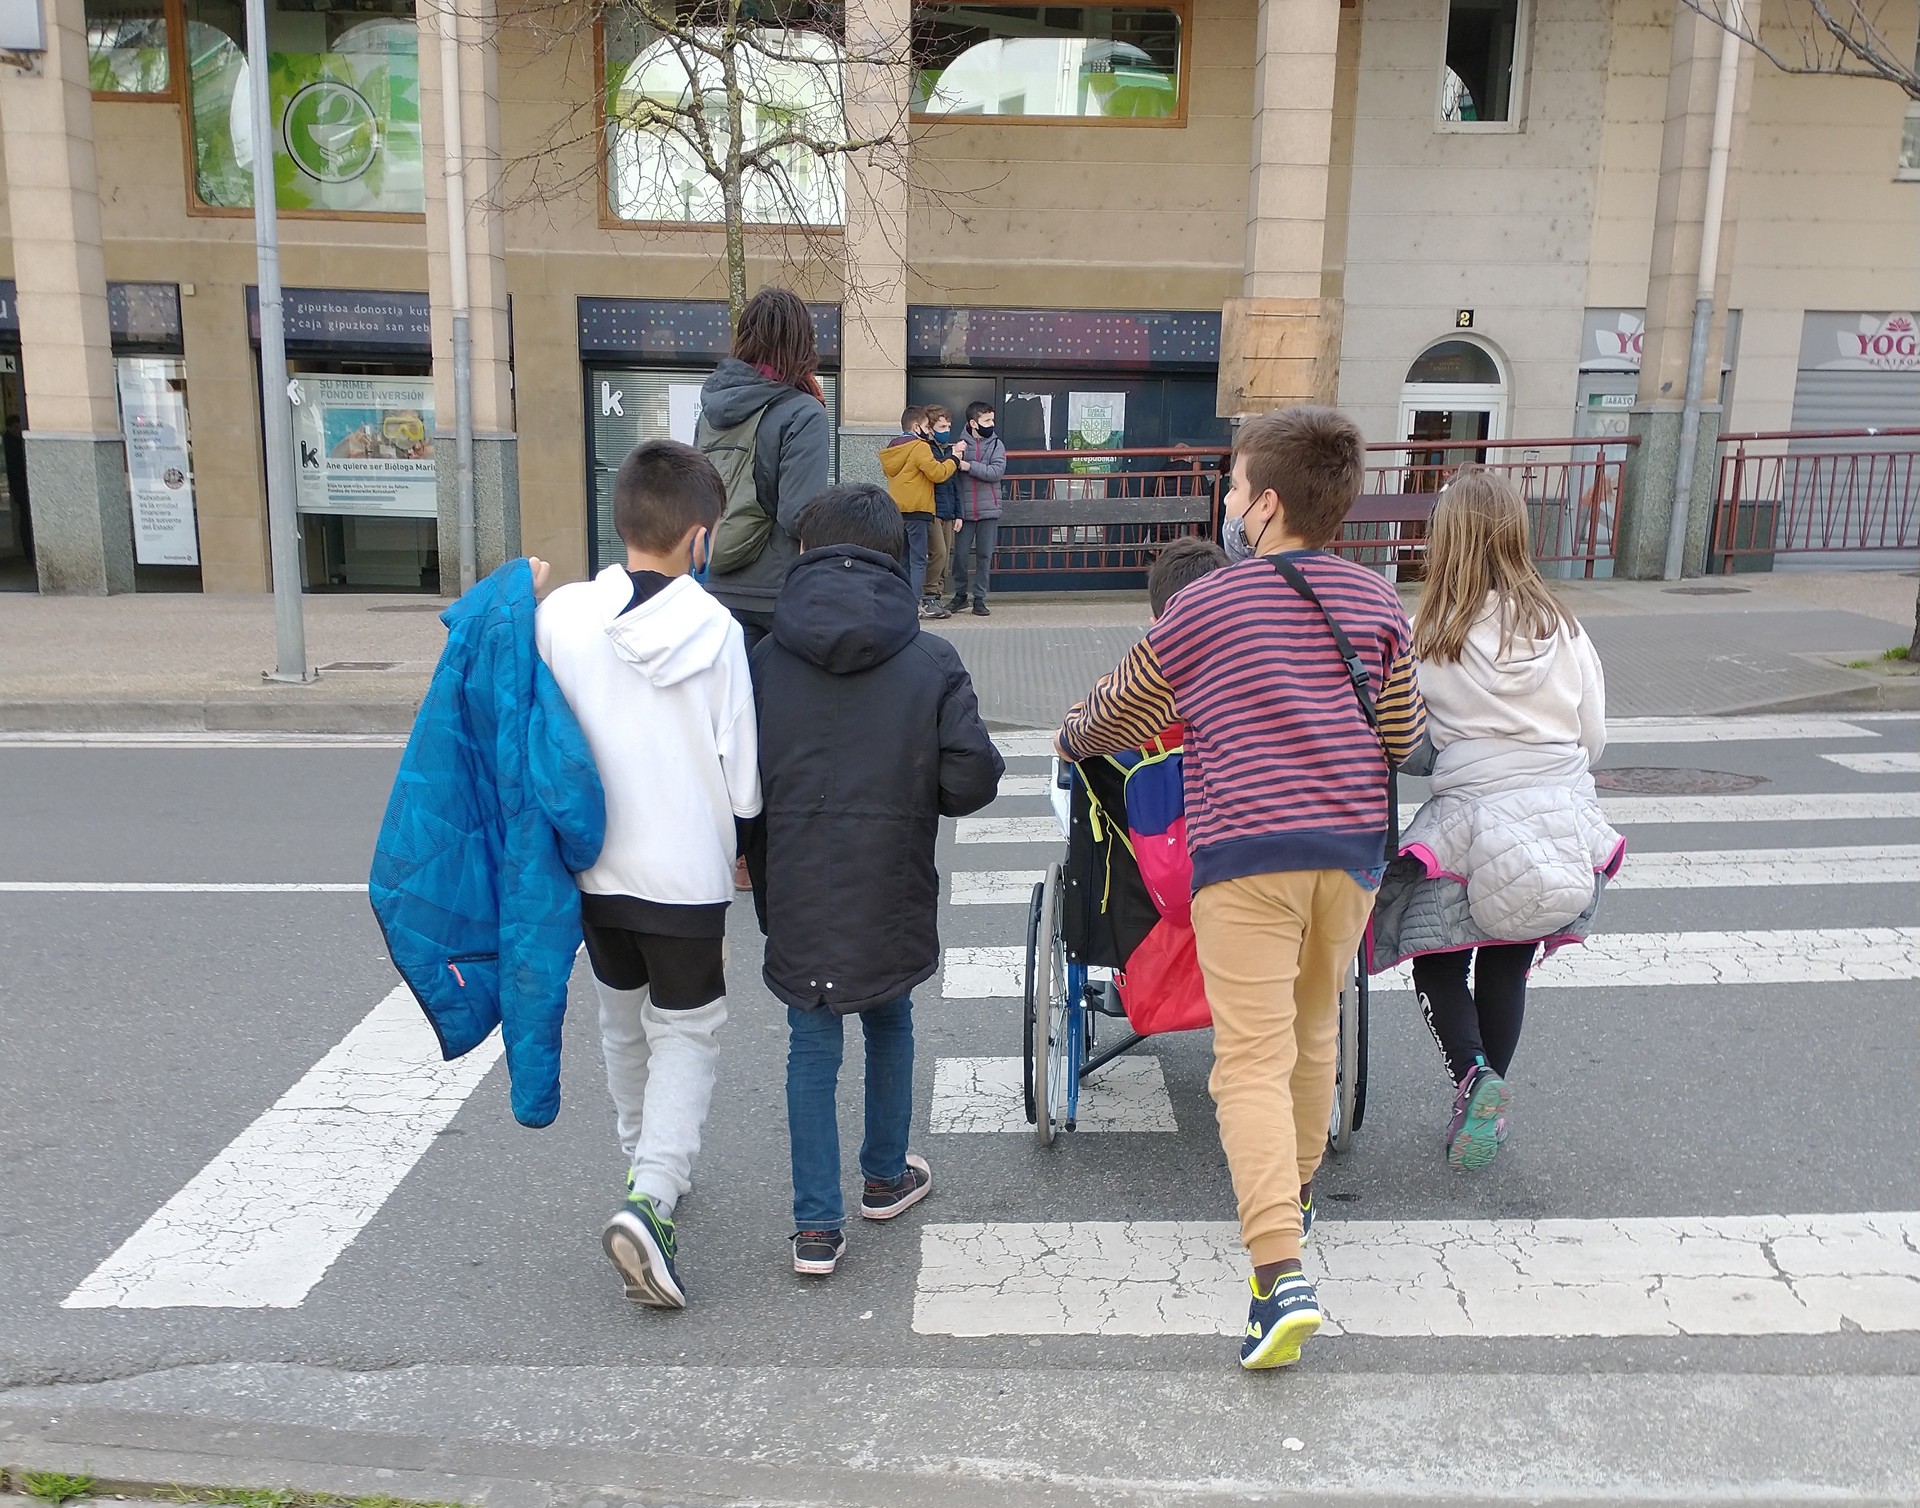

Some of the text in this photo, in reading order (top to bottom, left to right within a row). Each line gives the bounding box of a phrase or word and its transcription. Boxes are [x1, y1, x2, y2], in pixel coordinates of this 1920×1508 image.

[298, 303, 430, 316] gipuzkoa donostia kut
[1460, 311, 1470, 326] 2
[298, 319, 322, 331] caja
[328, 320, 379, 332] gipuzkoa
[385, 323, 404, 332] san
[1856, 334, 1920, 355] YOG
[320, 380, 373, 390] SU PRIMER
[320, 390, 353, 399] FONDO
[356, 391, 369, 399] DE
[602, 381, 624, 416] k
[301, 440, 319, 468] k
[326, 462, 341, 470] Ane
[343, 463, 367, 471] quiere
